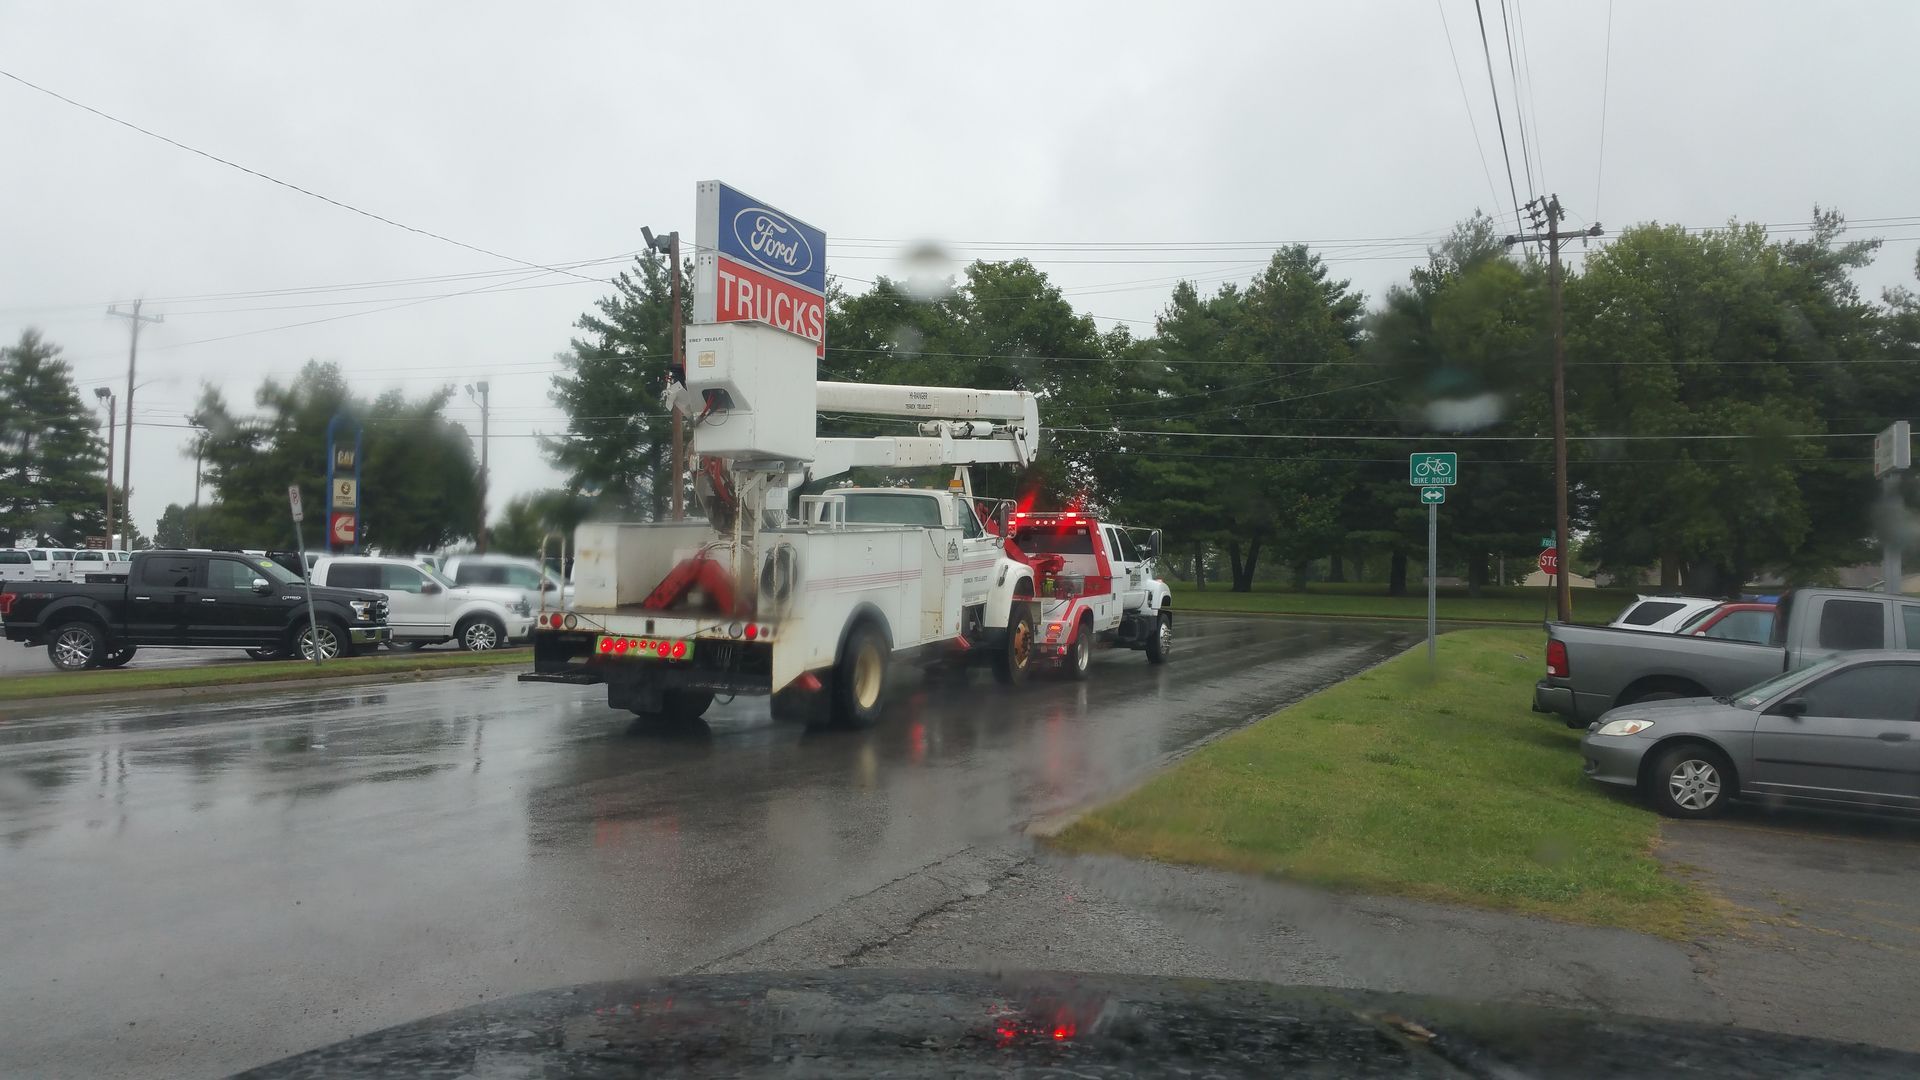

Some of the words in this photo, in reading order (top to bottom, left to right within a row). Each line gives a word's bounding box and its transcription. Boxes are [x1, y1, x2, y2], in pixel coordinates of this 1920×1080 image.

[751, 216, 799, 266] Ford
[719, 271, 823, 342] TRUCKS
[1431, 476, 1453, 484] ROUTE
[1541, 556, 1558, 567] STO
